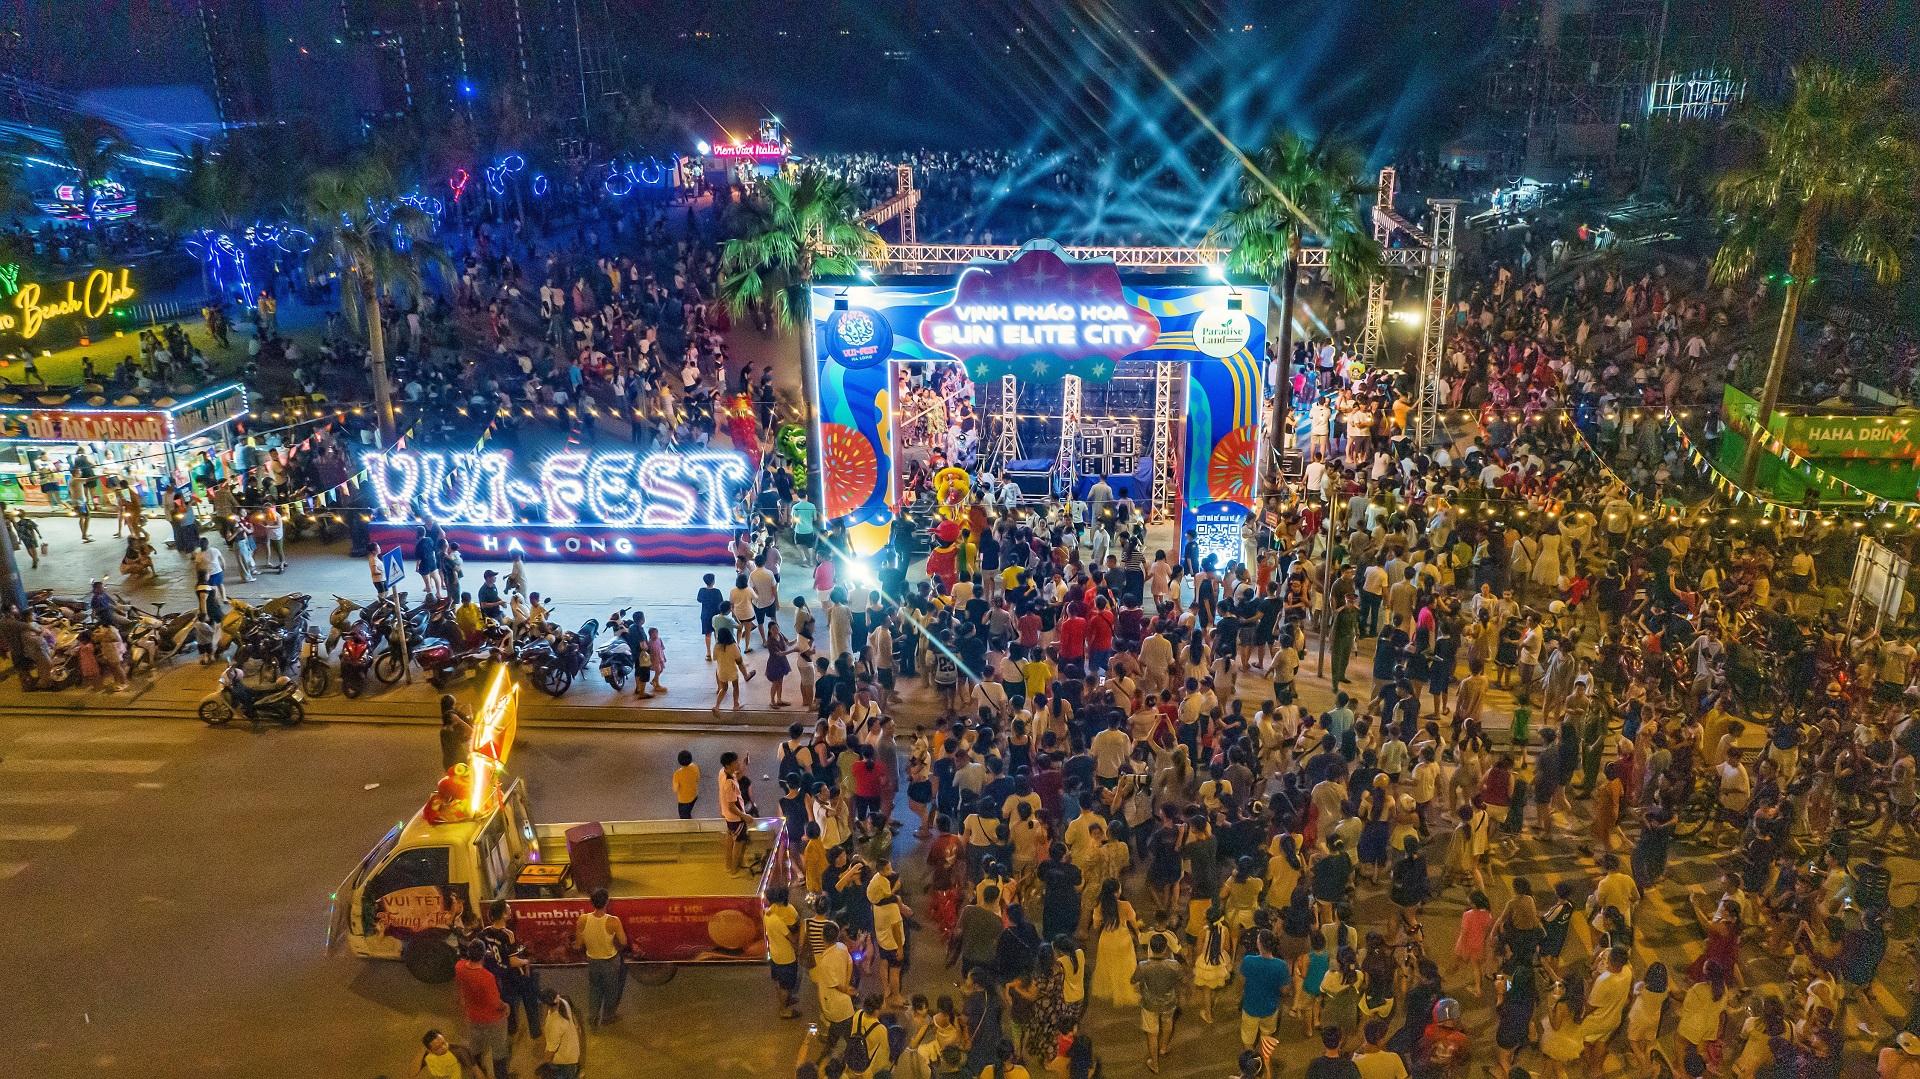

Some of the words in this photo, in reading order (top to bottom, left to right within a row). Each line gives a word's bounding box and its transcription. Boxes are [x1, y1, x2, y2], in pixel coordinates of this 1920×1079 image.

[15, 281, 82, 338] Beach
[84, 268, 135, 318] Club
[1014, 303, 1075, 321] PHÁO
[1081, 305, 1129, 321] HOA
[932, 324, 994, 344] SUN
[1003, 324, 1077, 345] ELITE
[1083, 324, 1147, 344] CITY
[1201, 327, 1243, 335] Paradise
[1202, 335, 1226, 344] Land
[1809, 427, 1854, 440] HAHA
[361, 450, 754, 529] VUI-FEST
[545, 536, 632, 554] LONG
[384, 896, 410, 907] VUI
[515, 908, 585, 919] Lumbini
